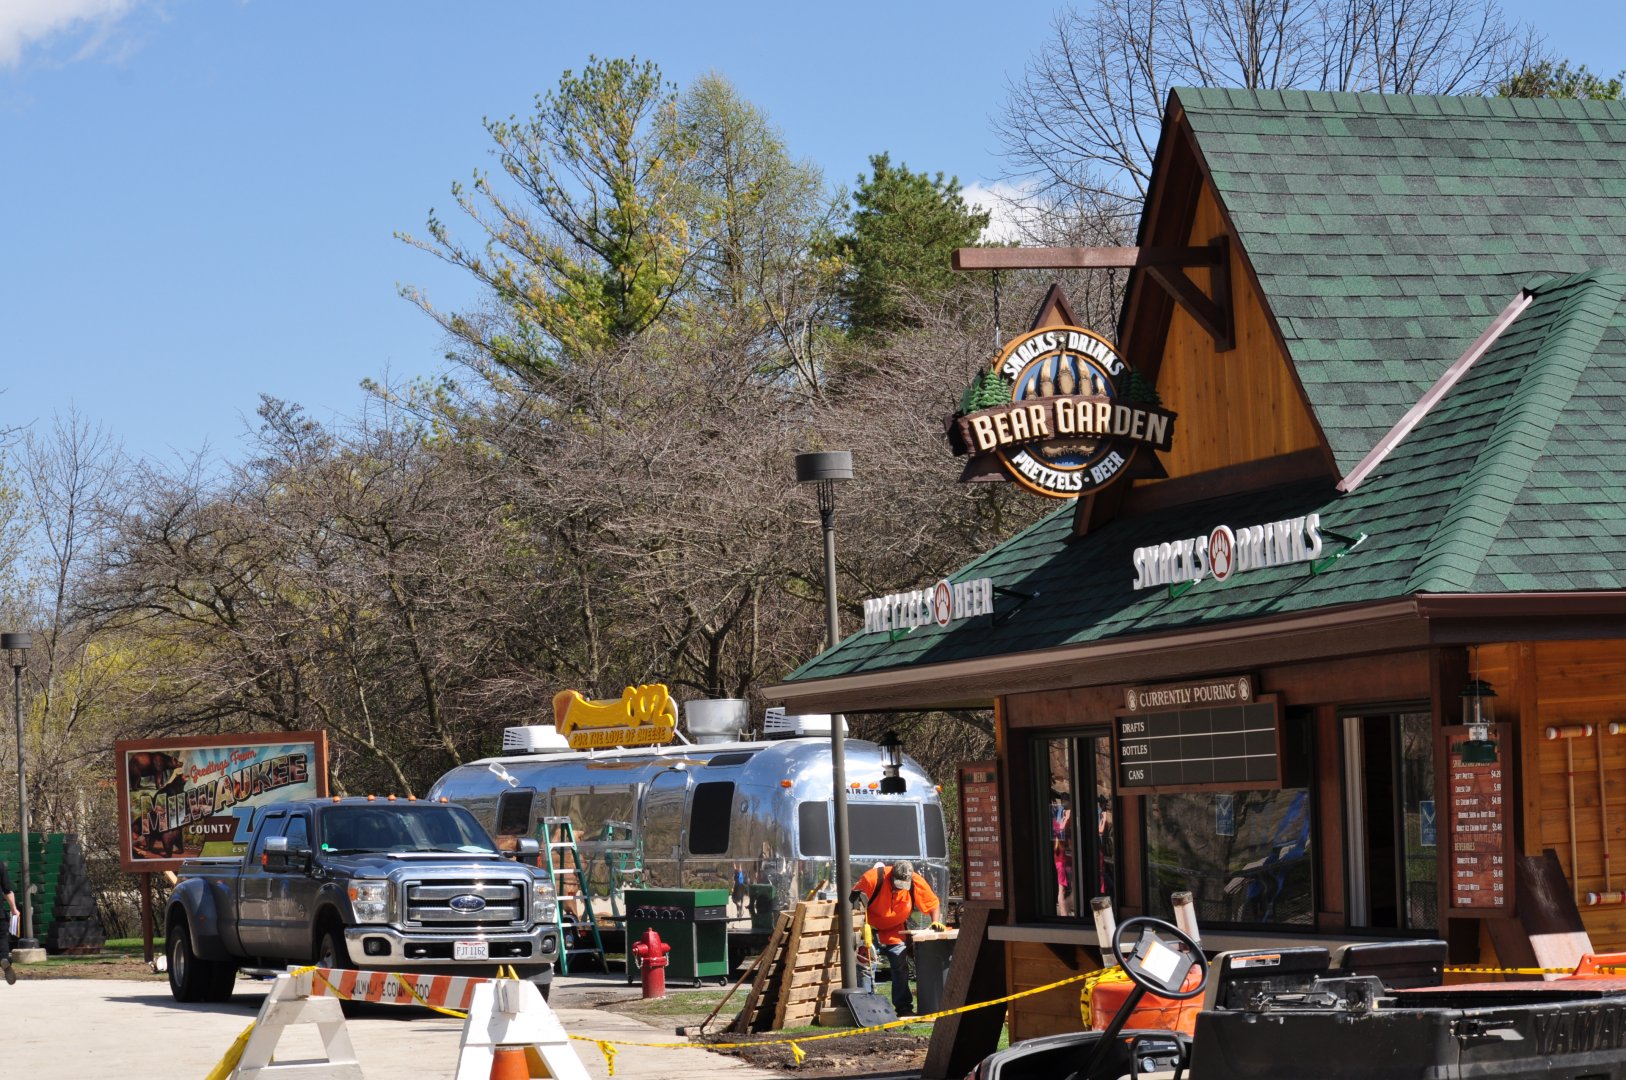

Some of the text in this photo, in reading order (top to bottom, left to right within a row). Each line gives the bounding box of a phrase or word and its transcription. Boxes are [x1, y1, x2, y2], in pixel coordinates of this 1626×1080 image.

[1003, 331, 1124, 380] SNACKS DRINKS
[970, 398, 1169, 450] BEAR GARDEN
[1012, 450, 1125, 491] PRETZELS BEER
[1133, 513, 1322, 590] SNACKS DRINKS
[864, 578, 994, 634] PRETZELS BEER
[1140, 683, 1236, 708] CURRENTLY POURING
[573, 727, 666, 746] FOR THE LOVE OF CHEESE
[1122, 722, 1145, 734] DRAFTS
[190, 750, 257, 784] Greetings From
[1122, 744, 1148, 756] BOTTLES
[1128, 770, 1144, 780] CANS
[140, 753, 308, 835] MILWAUKEE
[189, 824, 232, 834] COUNTY
